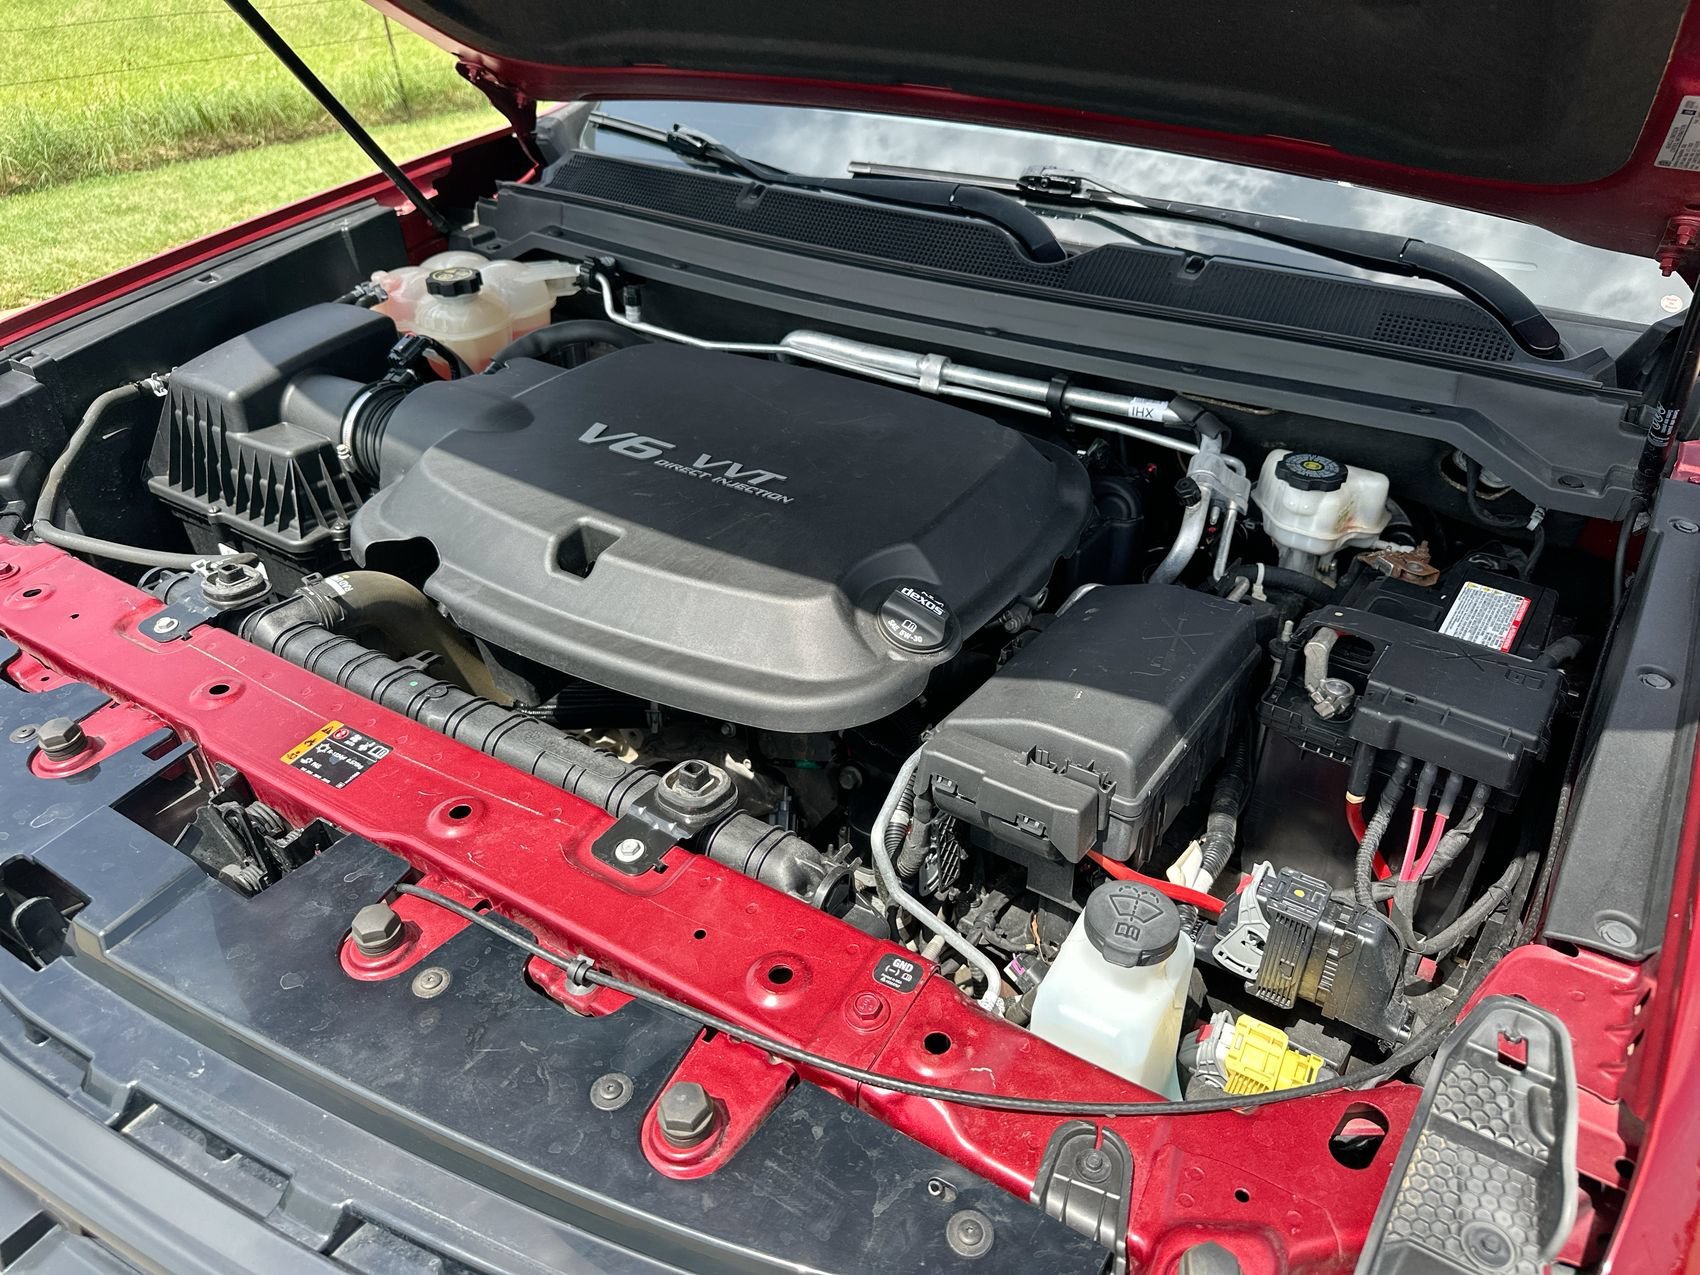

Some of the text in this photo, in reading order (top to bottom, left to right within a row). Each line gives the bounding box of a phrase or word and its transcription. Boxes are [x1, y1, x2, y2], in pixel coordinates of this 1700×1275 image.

[578, 422, 788, 485] V6 VVT
[654, 459, 794, 504] DIRECT INJECTION
[901, 587, 945, 615] dexos
[888, 619, 923, 642] SAE 5W-30
[893, 959, 914, 972] GND
